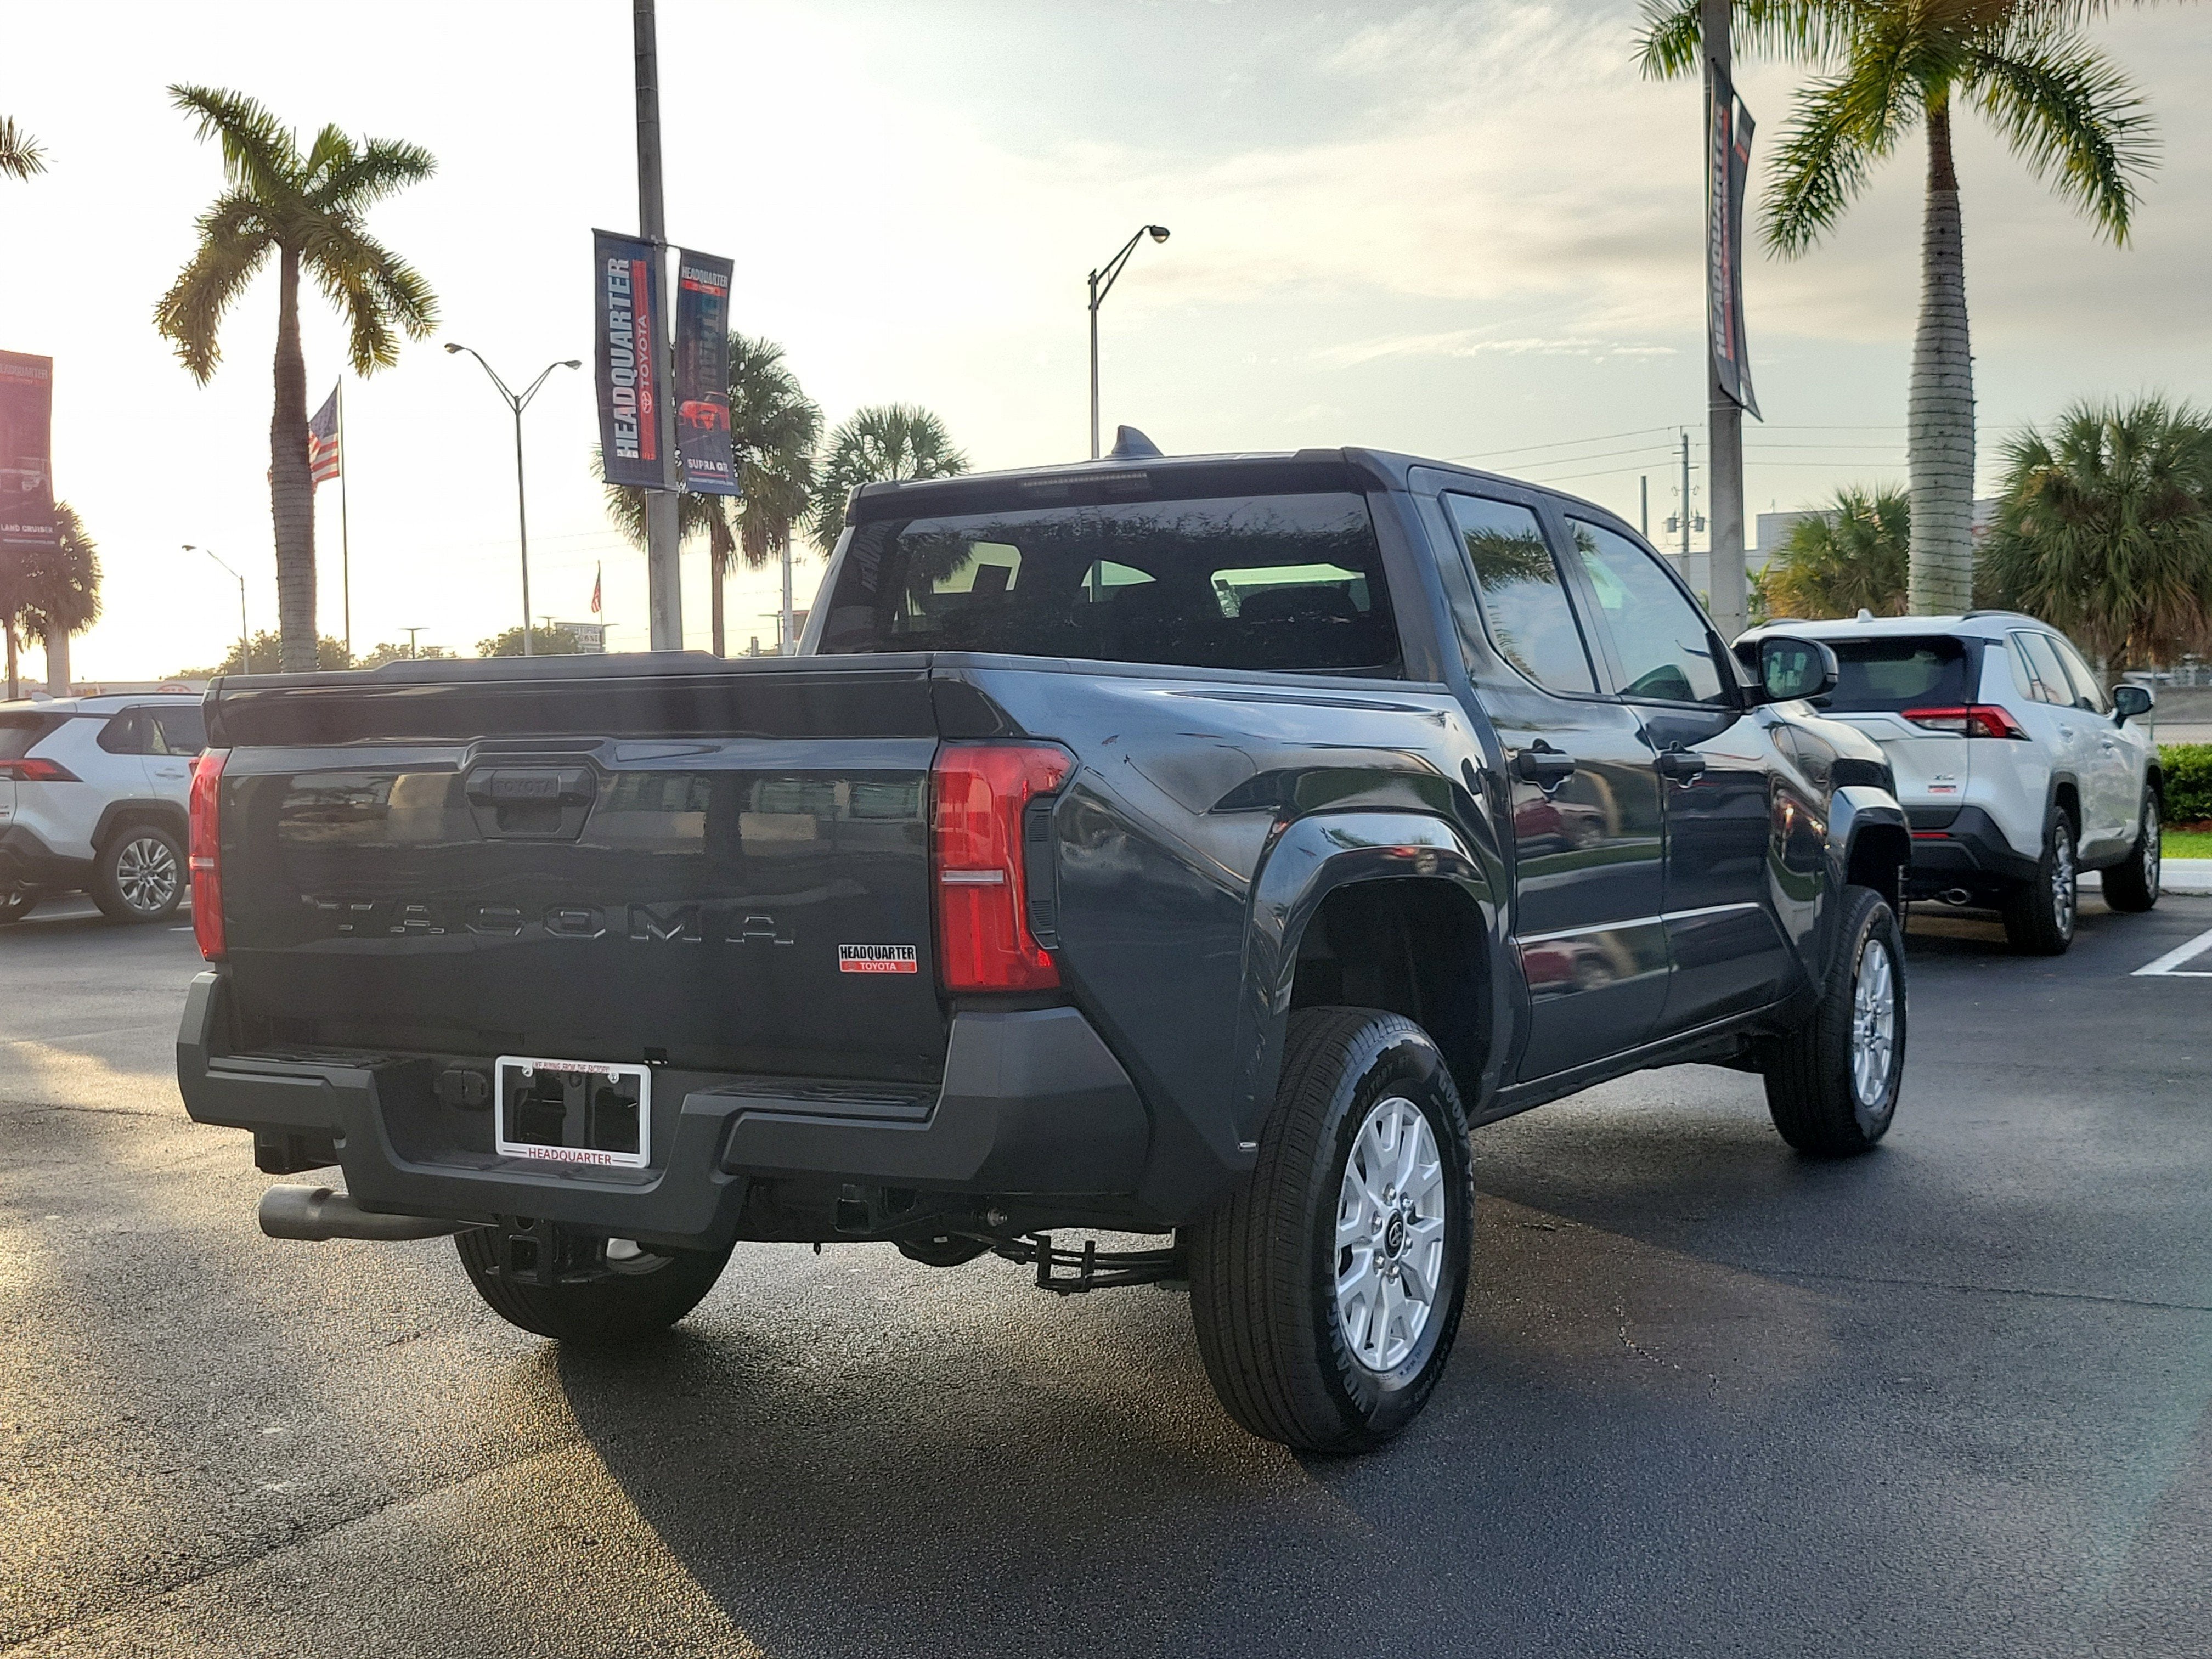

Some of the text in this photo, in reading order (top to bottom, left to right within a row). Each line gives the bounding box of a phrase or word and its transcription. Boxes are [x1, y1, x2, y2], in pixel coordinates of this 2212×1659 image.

[1712, 103, 1726, 358] HEADQUARTER
[681, 266, 728, 289] HEADQUARTER
[608, 258, 639, 459] HEADQUARTER
[637, 314, 650, 387] TOYOTA
[687, 458, 715, 471] SUPRA
[22, 525, 54, 533] CRUISER
[840, 946, 915, 960] HEADQUARTER
[860, 962, 897, 970] TOYOTA
[562, 1063, 575, 1071] FROM
[529, 1147, 612, 1165] HEADQUARTER
